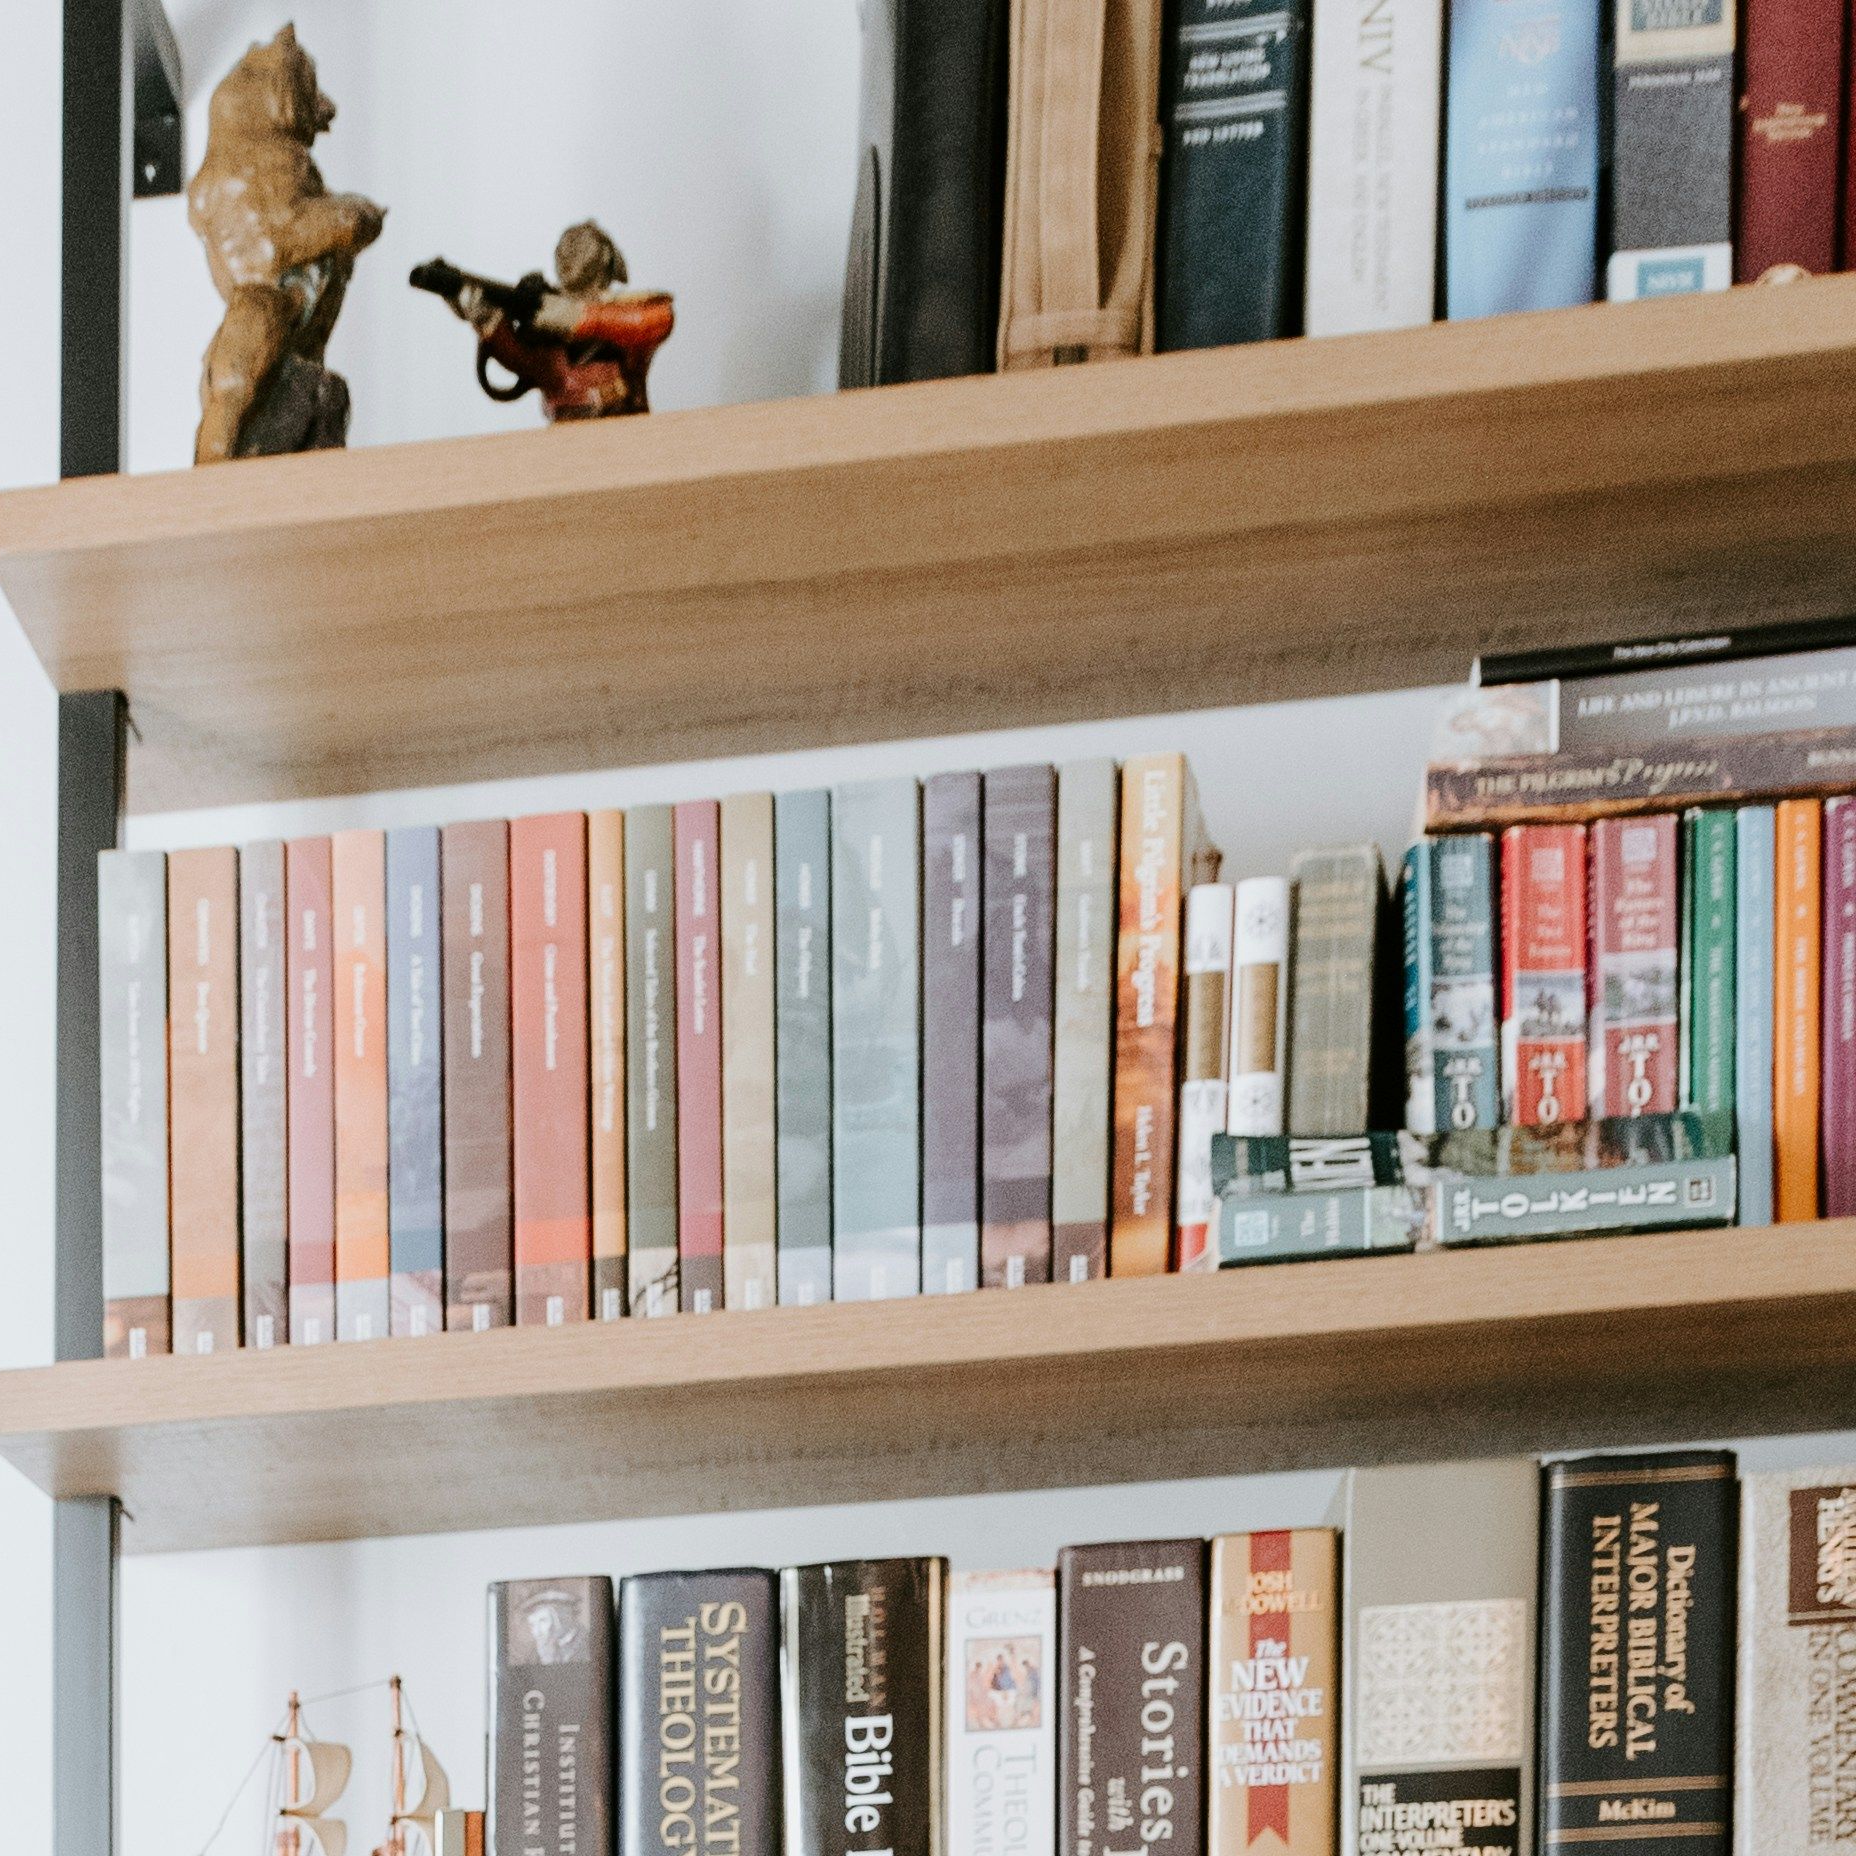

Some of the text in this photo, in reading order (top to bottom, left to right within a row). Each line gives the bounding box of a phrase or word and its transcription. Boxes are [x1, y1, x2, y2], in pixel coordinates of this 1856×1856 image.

[1141, 771, 1166, 832] Little
[1132, 934, 1160, 1027] Progress
[1472, 1180, 1677, 1218] TOLKIEN
[1082, 1566, 1185, 1587] SNODGRASS
[965, 1611, 1043, 1628] GRENZ
[1587, 1514, 1623, 1750] INTERPRETERS
[1624, 1501, 1661, 1761] MAJOR BIBLICAL
[1664, 1543, 1698, 1715] Dictionary of
[844, 1594, 870, 1702] Illustrated
[1079, 1647, 1096, 1661] A
[1255, 1638, 1286, 1658] The
[1231, 1656, 1309, 1692] NEW
[1219, 1688, 1324, 1721] EVIDENCE
[1073, 1664, 1096, 1786] Comprehensive
[1139, 1640, 1189, 1842] Stories
[1242, 1718, 1297, 1744] THAT
[522, 1689, 545, 1835] CHRISTIAN
[1218, 1740, 1323, 1767] DEMANDS
[843, 1713, 895, 1833] Bible
[1234, 1760, 1323, 1786] VERDICT
[1077, 1788, 1096, 1834] Guide
[1107, 1777, 1133, 1832] with
[1361, 1783, 1396, 1806] THE
[1598, 1797, 1677, 1823] McKim
[1361, 1799, 1516, 1831] INTERPRETER'S
[1077, 1839, 1094, 1856] to
[1360, 1828, 1465, 1852] ONE-VOLUME
